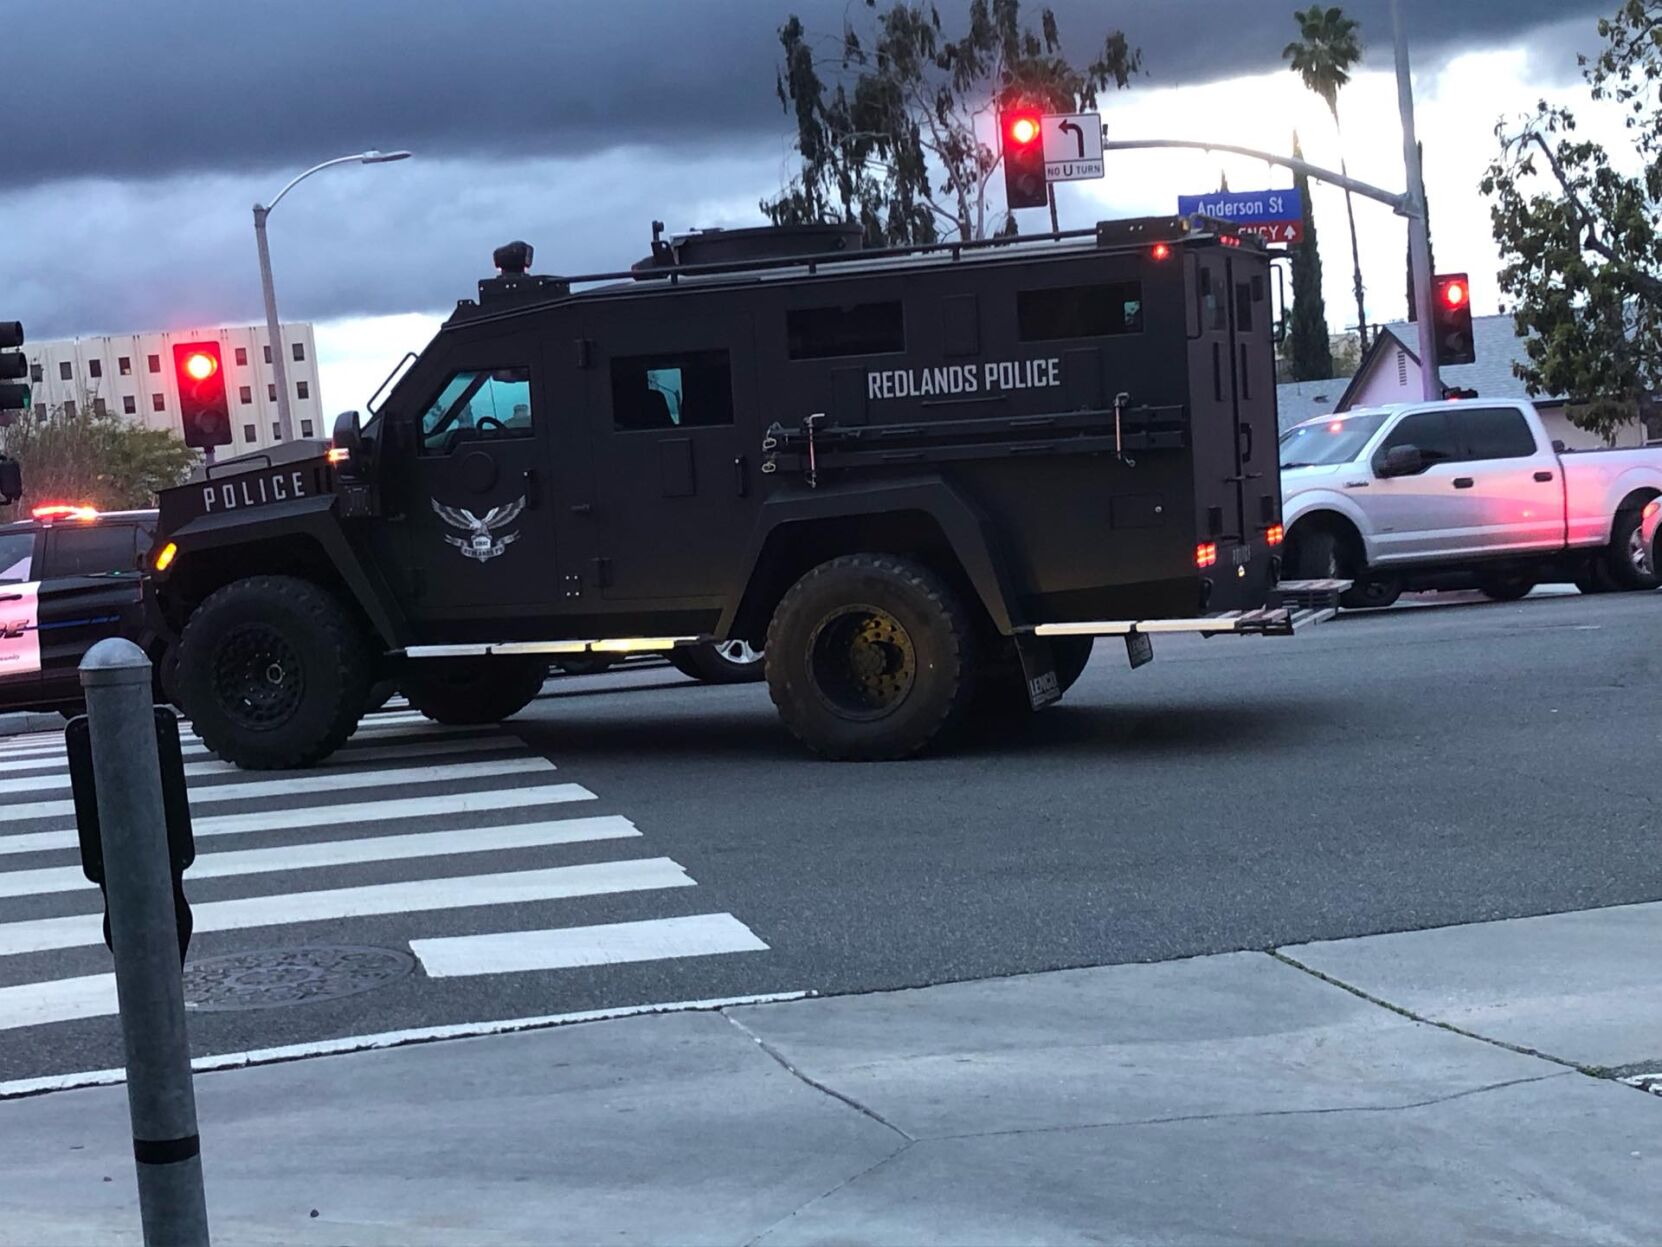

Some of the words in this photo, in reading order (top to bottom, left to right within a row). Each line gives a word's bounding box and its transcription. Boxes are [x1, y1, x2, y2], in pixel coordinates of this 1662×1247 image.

[1047, 167, 1060, 177] NO
[1063, 164, 1073, 177] U
[1076, 164, 1101, 175] TURN
[1198, 200, 1263, 217] Anderson
[1269, 196, 1284, 214] St
[868, 364, 978, 400] REDLANDS
[984, 358, 1061, 391] POLICE
[203, 471, 305, 513] POLICE
